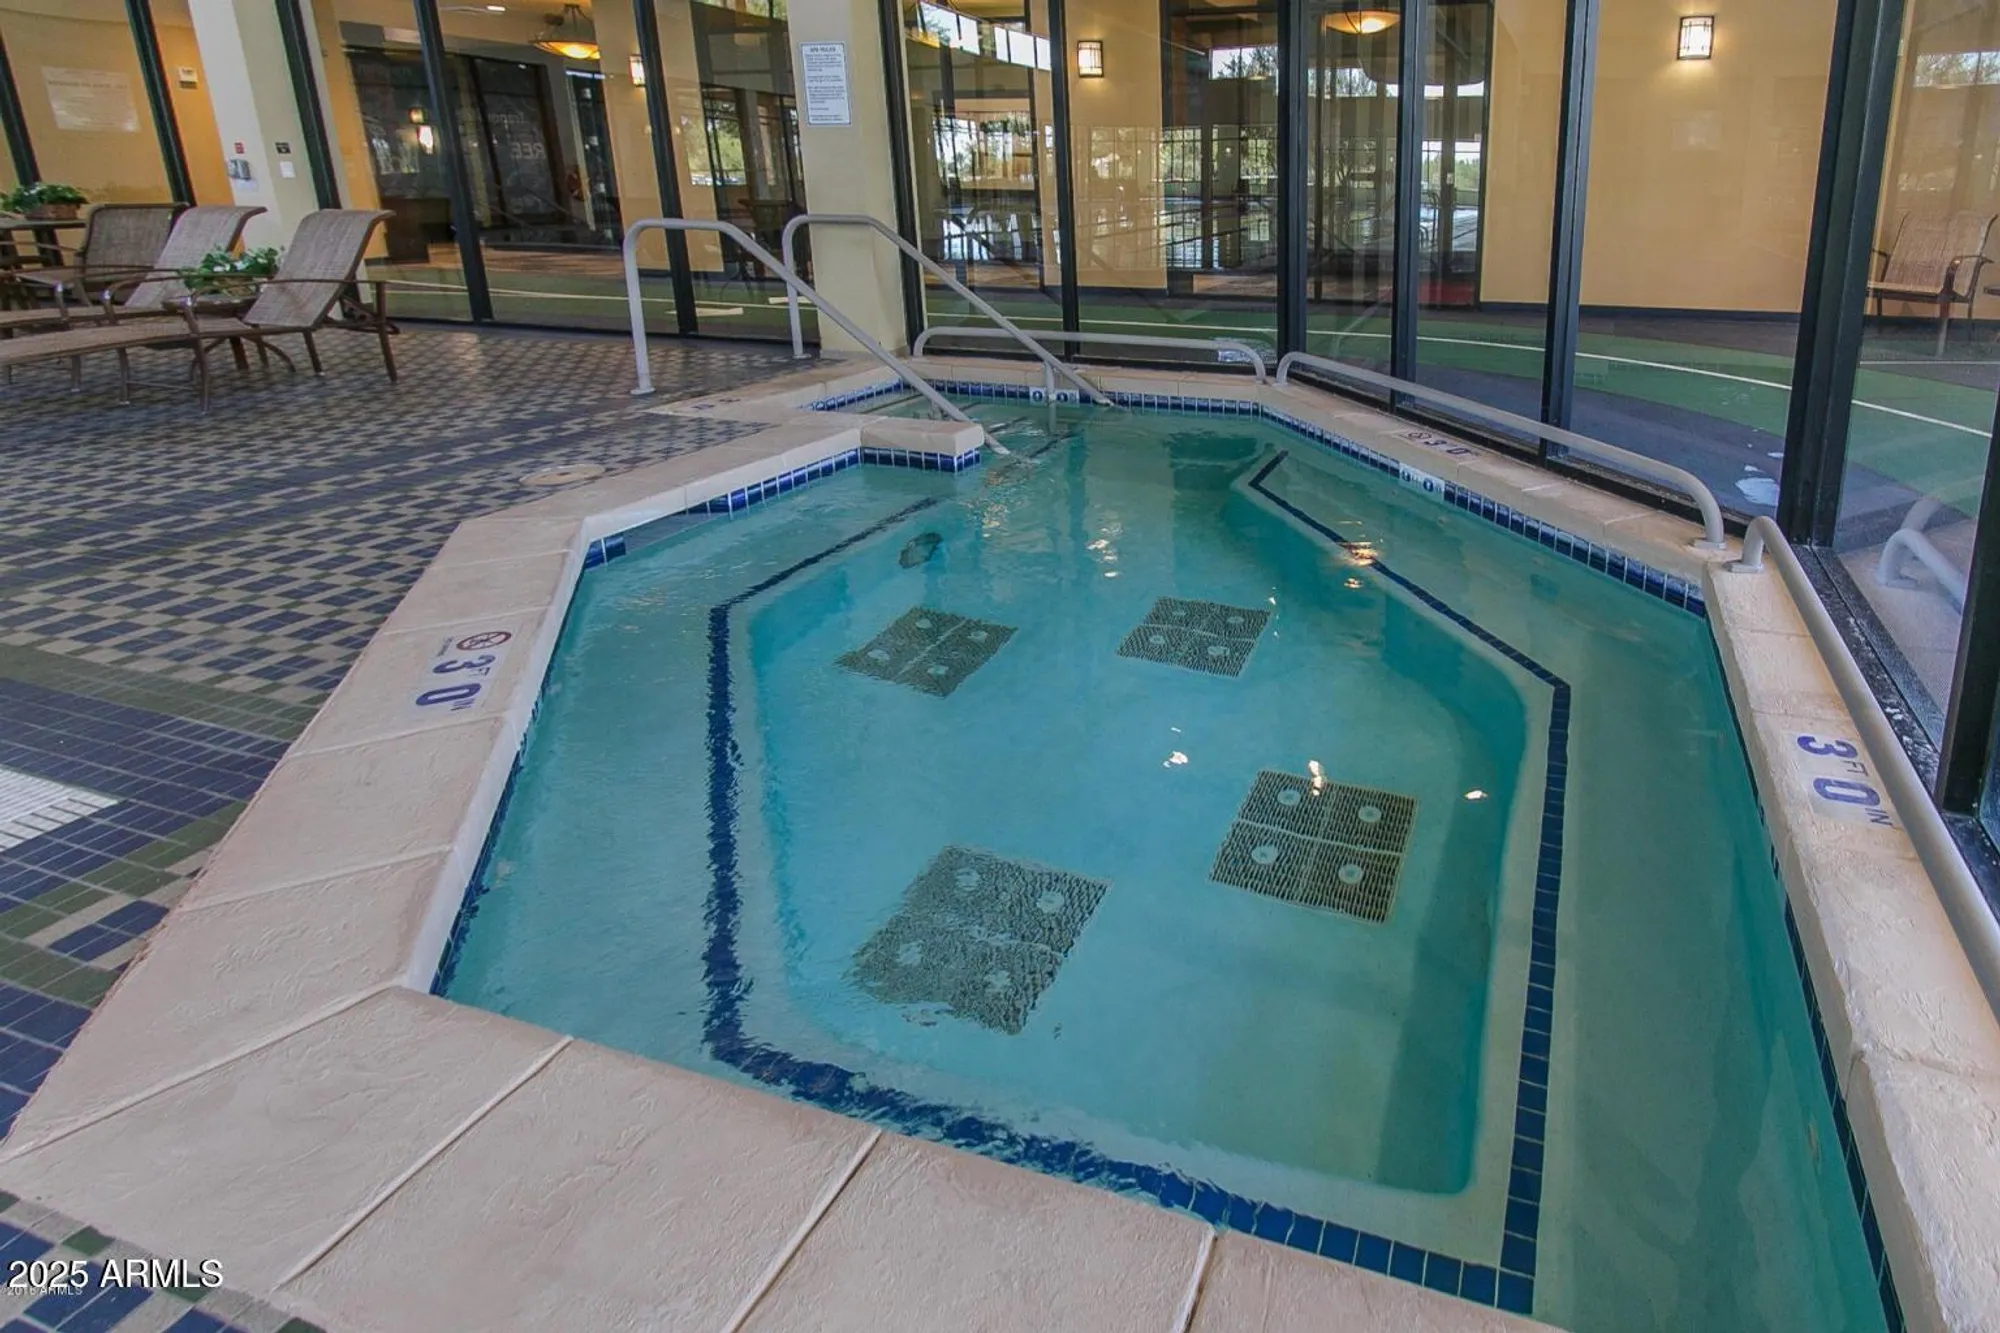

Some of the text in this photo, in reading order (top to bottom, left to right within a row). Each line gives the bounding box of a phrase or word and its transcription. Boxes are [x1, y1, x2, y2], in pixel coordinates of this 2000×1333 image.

[432, 654, 496, 674] 3
[415, 682, 482, 706] 0
[1796, 735, 1893, 826] 3 FT 0 IN
